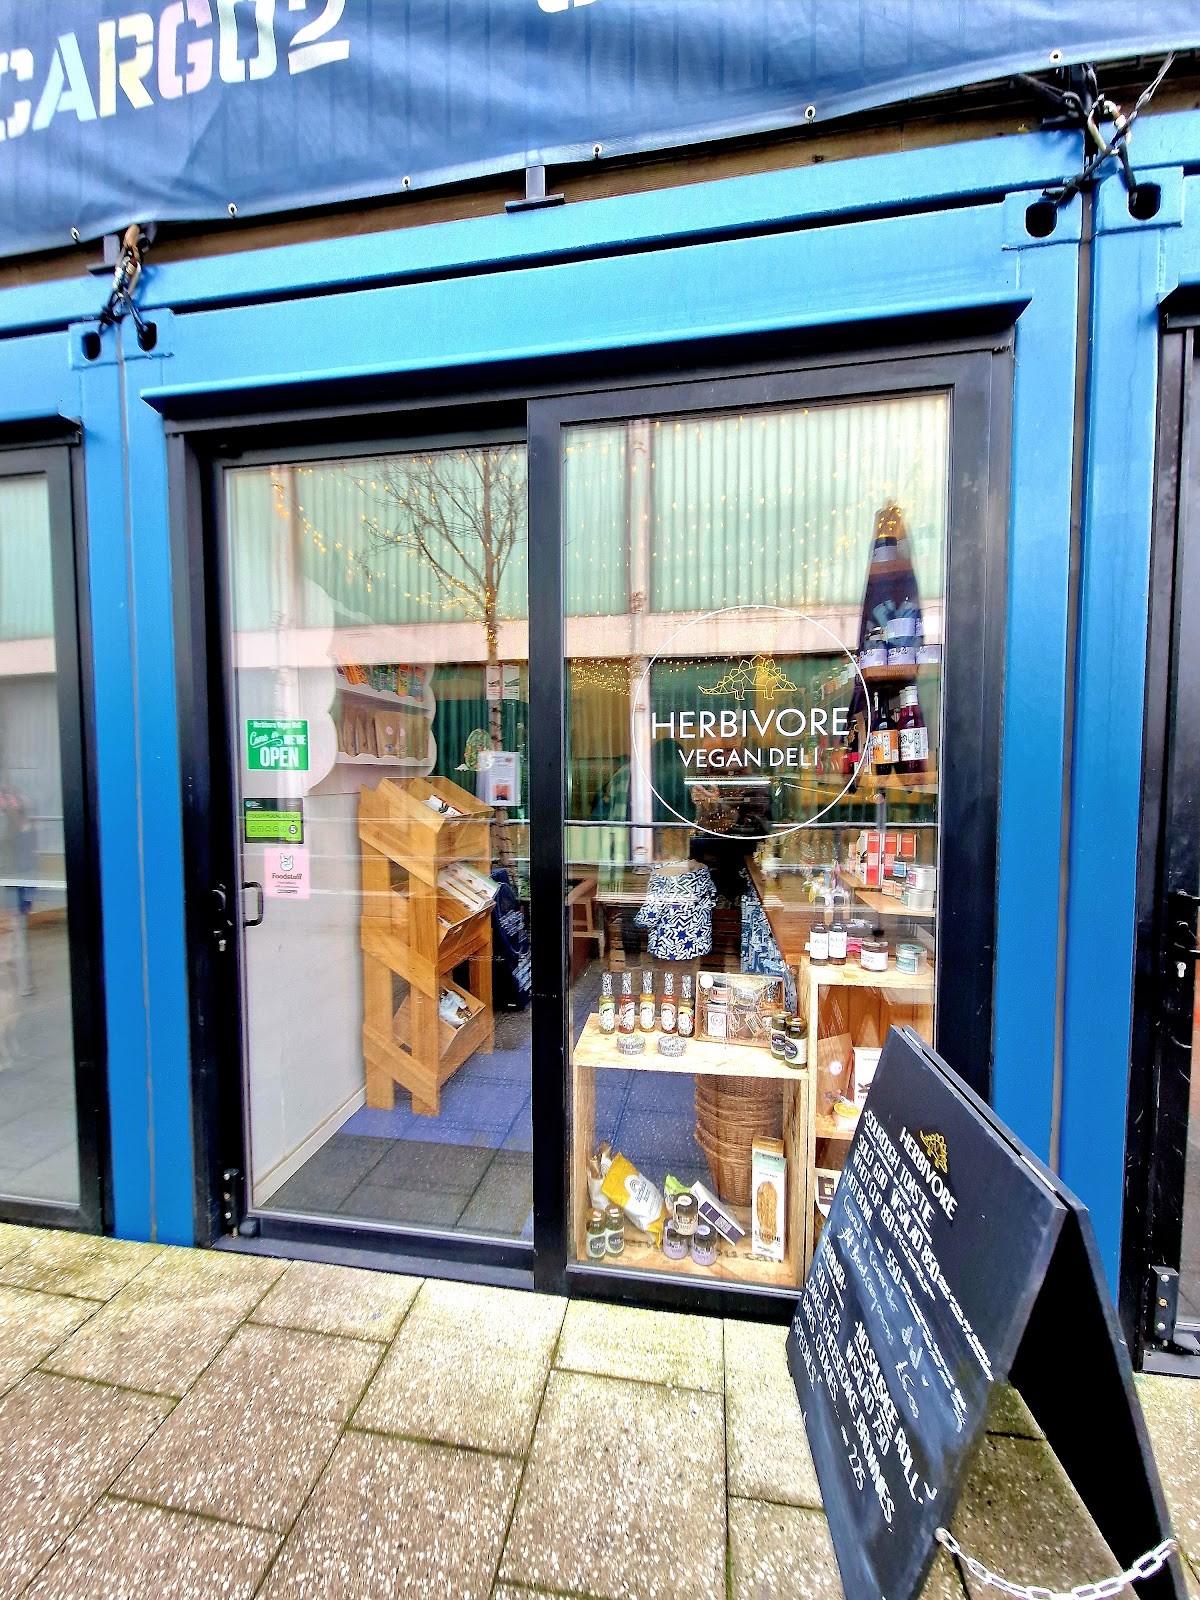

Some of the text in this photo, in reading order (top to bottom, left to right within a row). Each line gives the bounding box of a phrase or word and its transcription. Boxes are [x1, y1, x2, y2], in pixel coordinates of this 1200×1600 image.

[651, 707, 850, 739] HERBIVORE
[259, 746, 300, 767] OPEN
[678, 747, 818, 768] VEGAN DELI
[857, 1133, 875, 1167] SOLO
[899, 1126, 959, 1221] HERBIVORE
[845, 1170, 860, 1196] HOT
[855, 1188, 874, 1230] BOWL
[898, 1163, 935, 1228] TOASTIE
[815, 1261, 830, 1300] SOLO
[894, 1426, 920, 1502] ROLL
